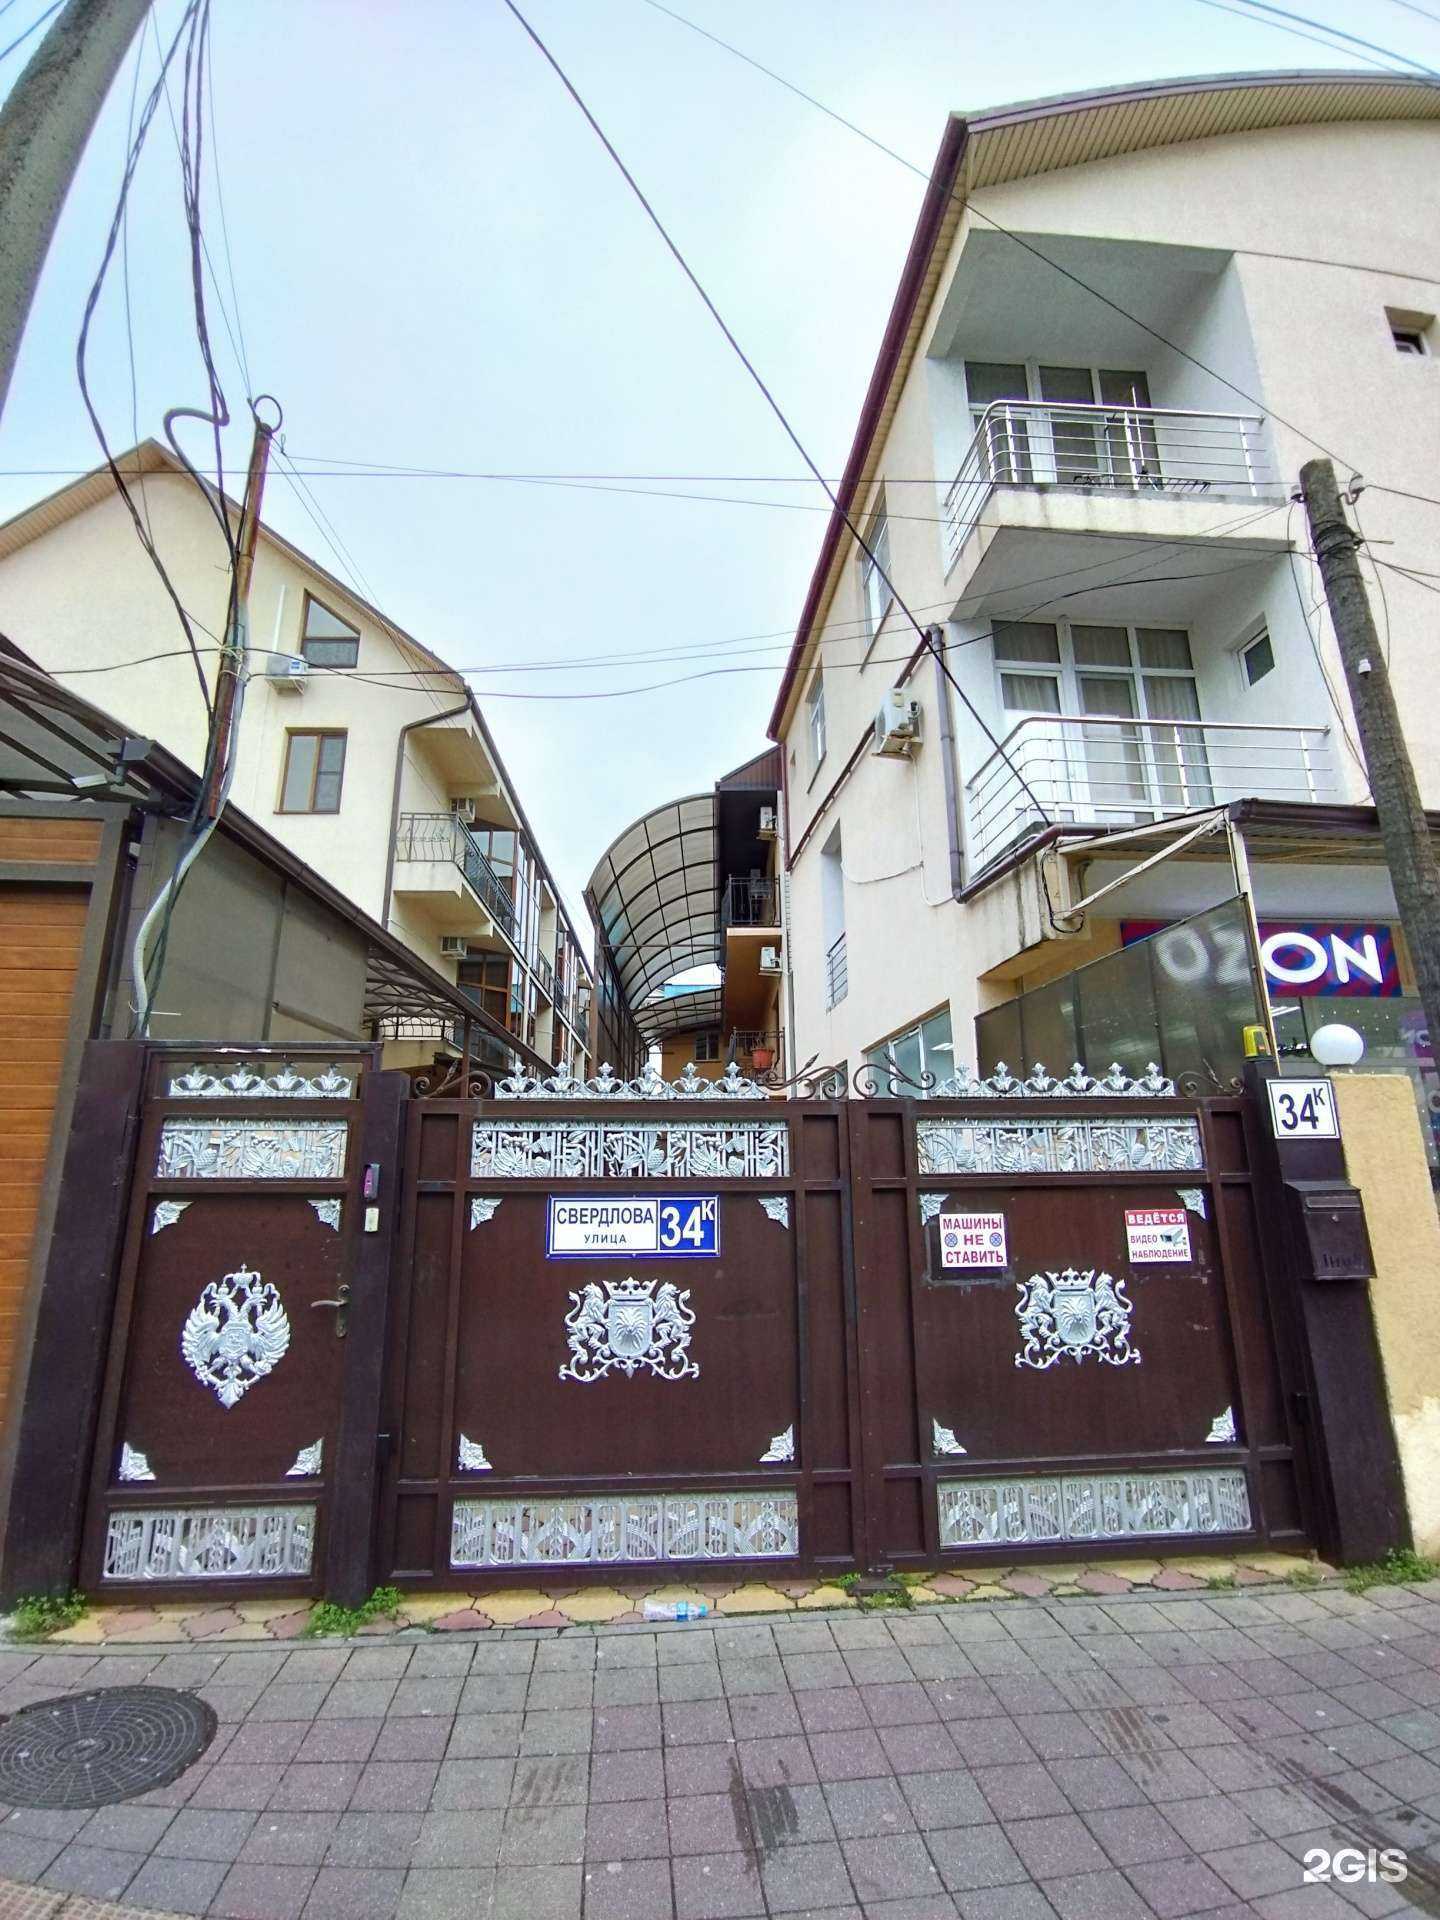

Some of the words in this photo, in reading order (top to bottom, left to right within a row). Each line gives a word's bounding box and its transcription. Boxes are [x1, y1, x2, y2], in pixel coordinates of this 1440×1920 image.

[1156, 927, 1383, 984] OZON
[557, 1207, 654, 1227] СВЕРДЛОВА
[1127, 1212, 1185, 1225] ВЕДЁТСЯ
[943, 1218, 1002, 1230] МАШИНЫ
[584, 1234, 627, 1244] УЛИЦА
[963, 1234, 984, 1246] НЕ
[1130, 1234, 1158, 1244] ВИДЕО
[945, 1250, 1004, 1264] СТАВИТЬ
[1132, 1249, 1188, 1259] НАБЛЮДЕНИЕ
